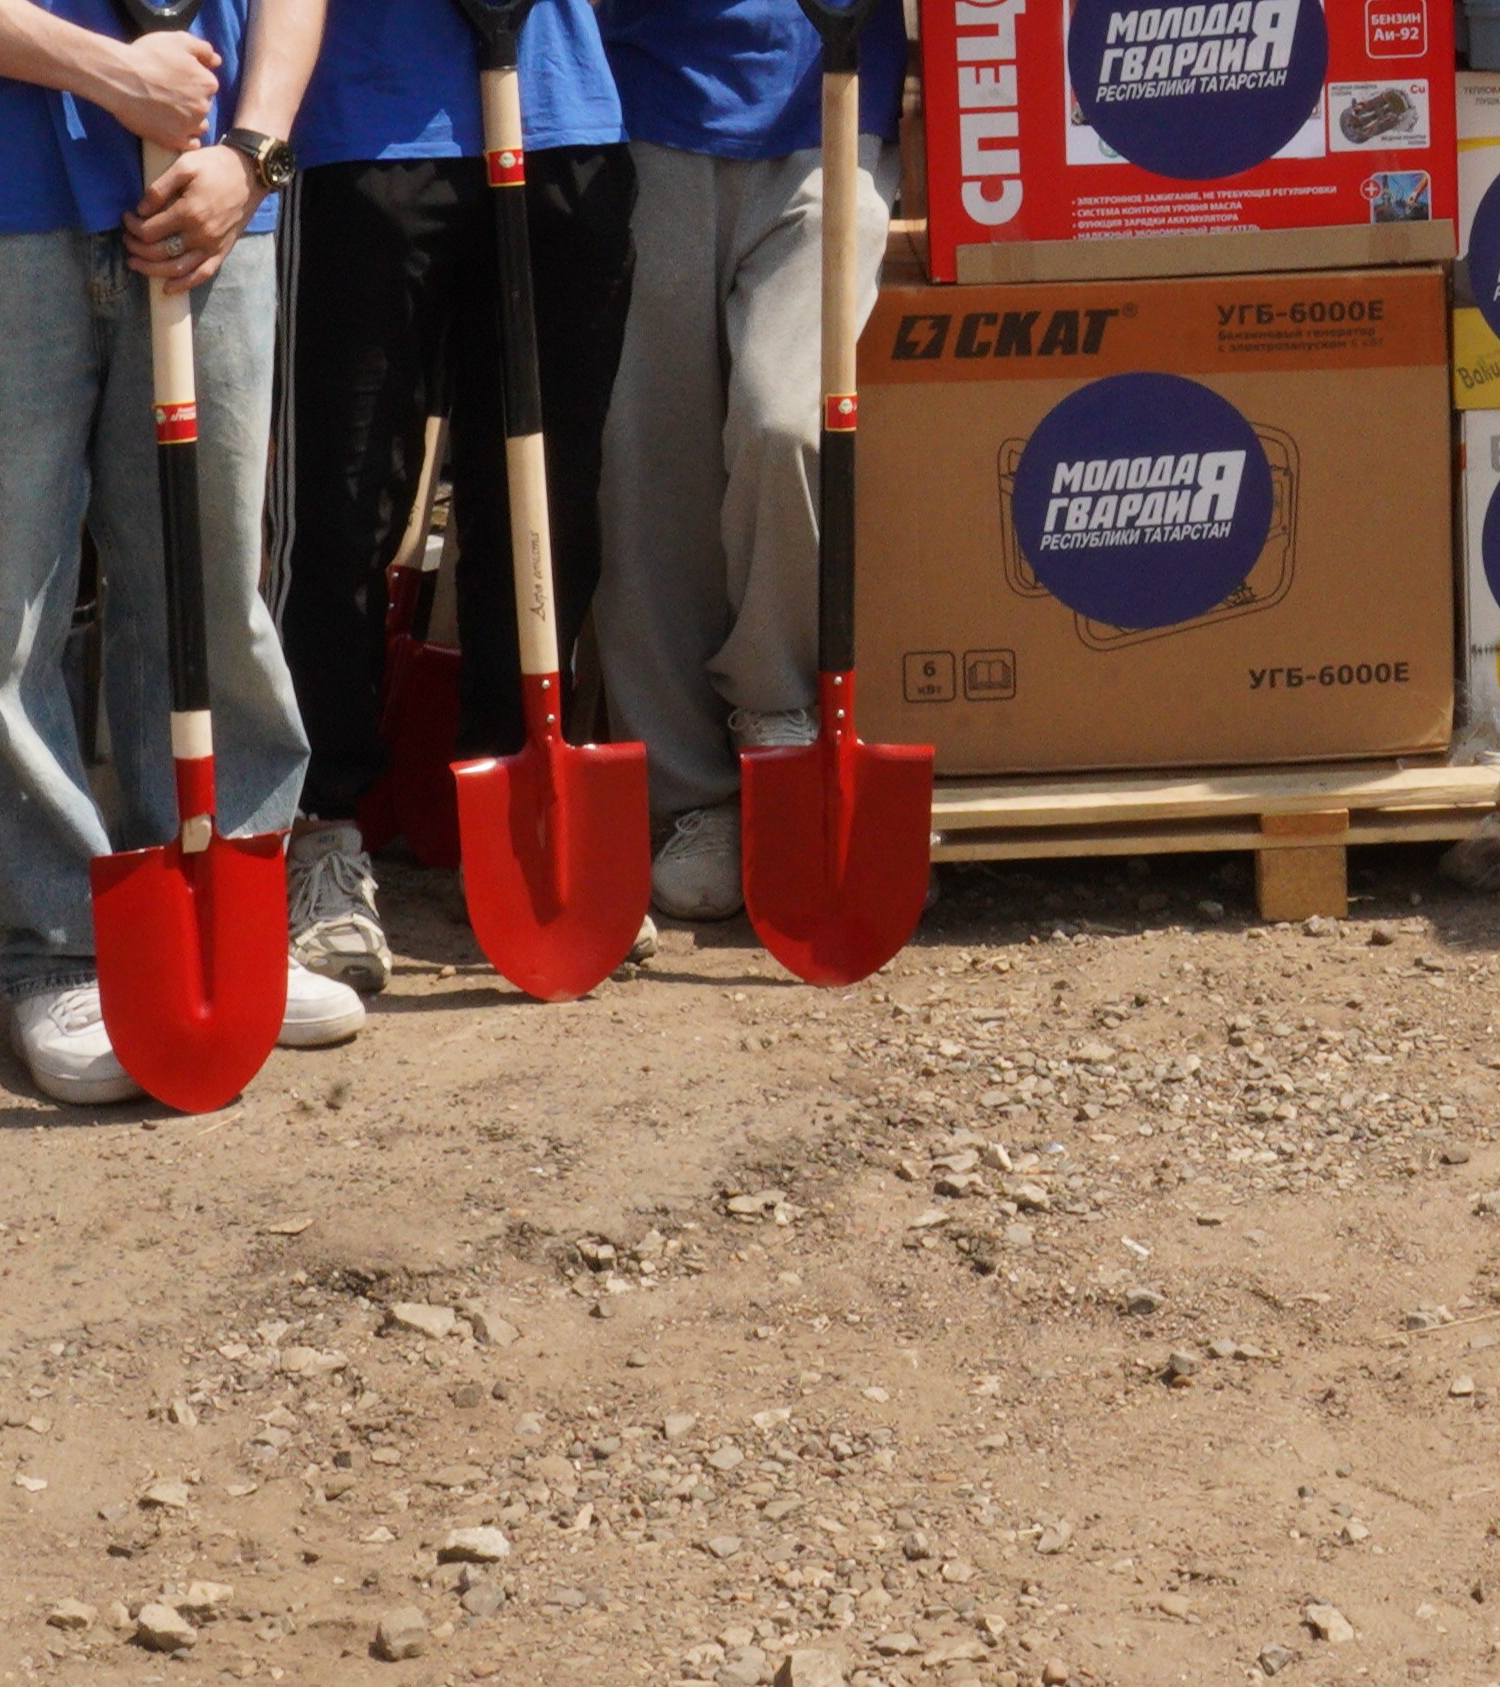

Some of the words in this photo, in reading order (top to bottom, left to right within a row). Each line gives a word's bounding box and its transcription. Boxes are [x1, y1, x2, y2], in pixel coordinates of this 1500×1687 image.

[1371, 12, 1421, 26] БЕНЗИН
[1373, 26, 1420, 43] Аи-92
[1096, 78, 1197, 103] РЕСПУБЛИКИ
[1200, 70, 1287, 95] ТАТАРСТАН
[954, 308, 1120, 358] СКАТ
[1051, 450, 1246, 494] МОЛОДАЯ
[1040, 526, 1140, 551] РЕСПУБЛИКИ
[1143, 520, 1232, 545] ТАТАРСТАН
[924, 661, 935, 677] 6
[1249, 662, 1410, 690] УГБ-6000Е
